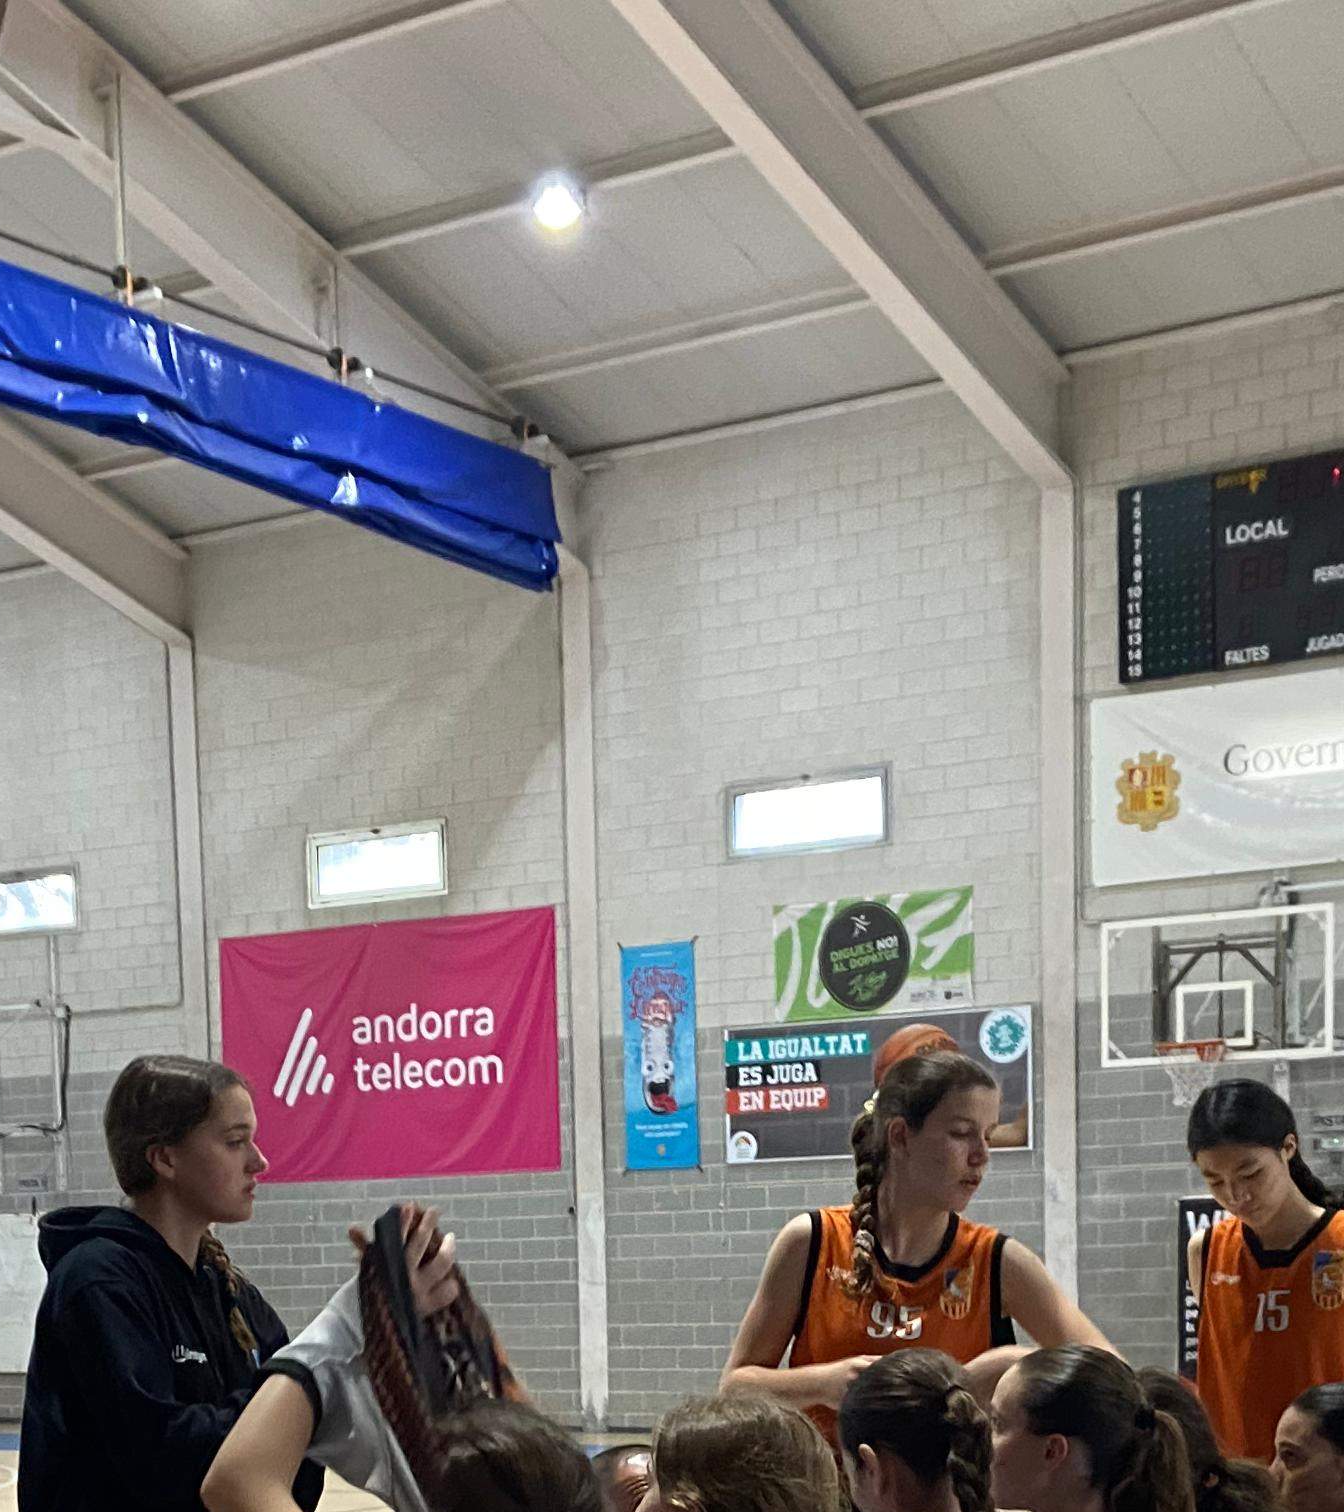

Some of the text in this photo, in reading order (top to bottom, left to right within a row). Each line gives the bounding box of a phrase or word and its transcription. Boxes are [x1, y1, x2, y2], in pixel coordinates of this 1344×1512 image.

[1225, 518, 1289, 545] LOCAL
[1127, 601, 1141, 615] 11
[1127, 617, 1142, 631] 12
[1127, 633, 1142, 646] 13
[1224, 644, 1270, 666] FALTES
[352, 1003, 494, 1045] andorra
[737, 1033, 868, 1062] LA IGUALTAT
[354, 1052, 504, 1092] telecom
[738, 1062, 818, 1087] ES JUGA
[739, 1087, 827, 1111] EN EQUIP
[1254, 1289, 1292, 1333] 15
